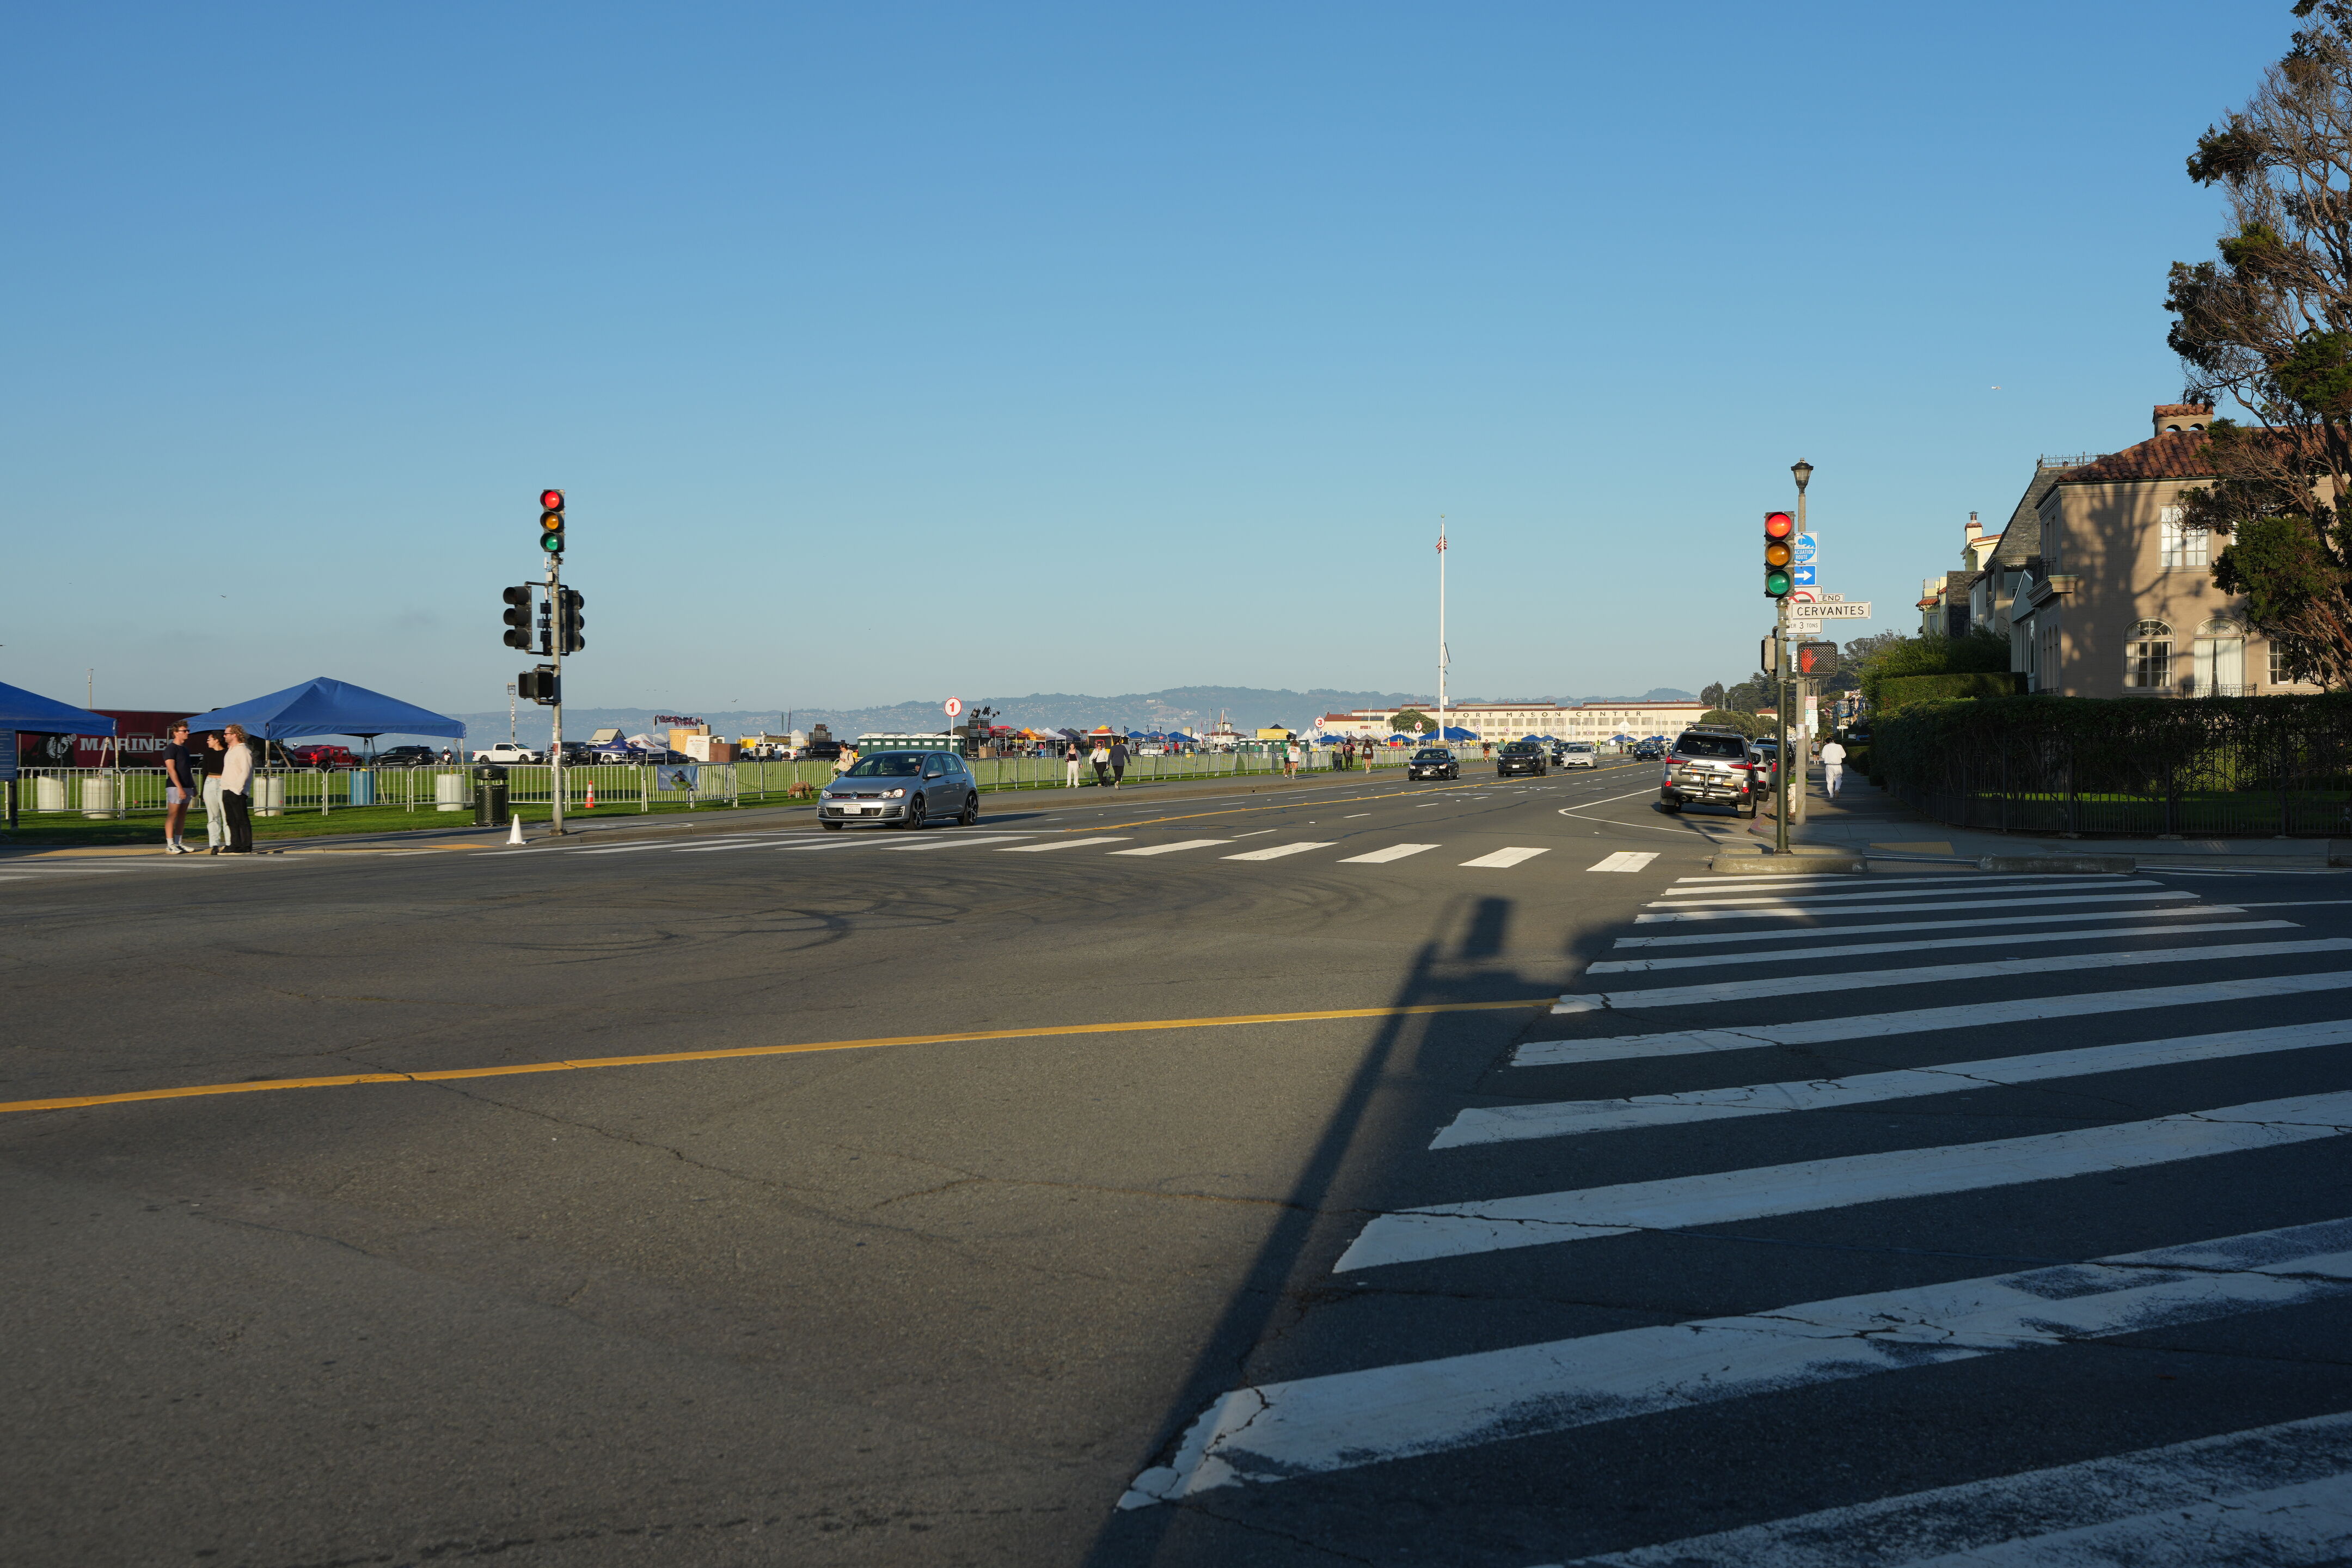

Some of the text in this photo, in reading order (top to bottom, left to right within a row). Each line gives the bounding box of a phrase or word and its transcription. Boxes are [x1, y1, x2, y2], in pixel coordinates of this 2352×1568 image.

[1797, 606, 1864, 616] CERVANTES
[950, 702, 954, 712] 1
[80, 738, 174, 751] MARINE
